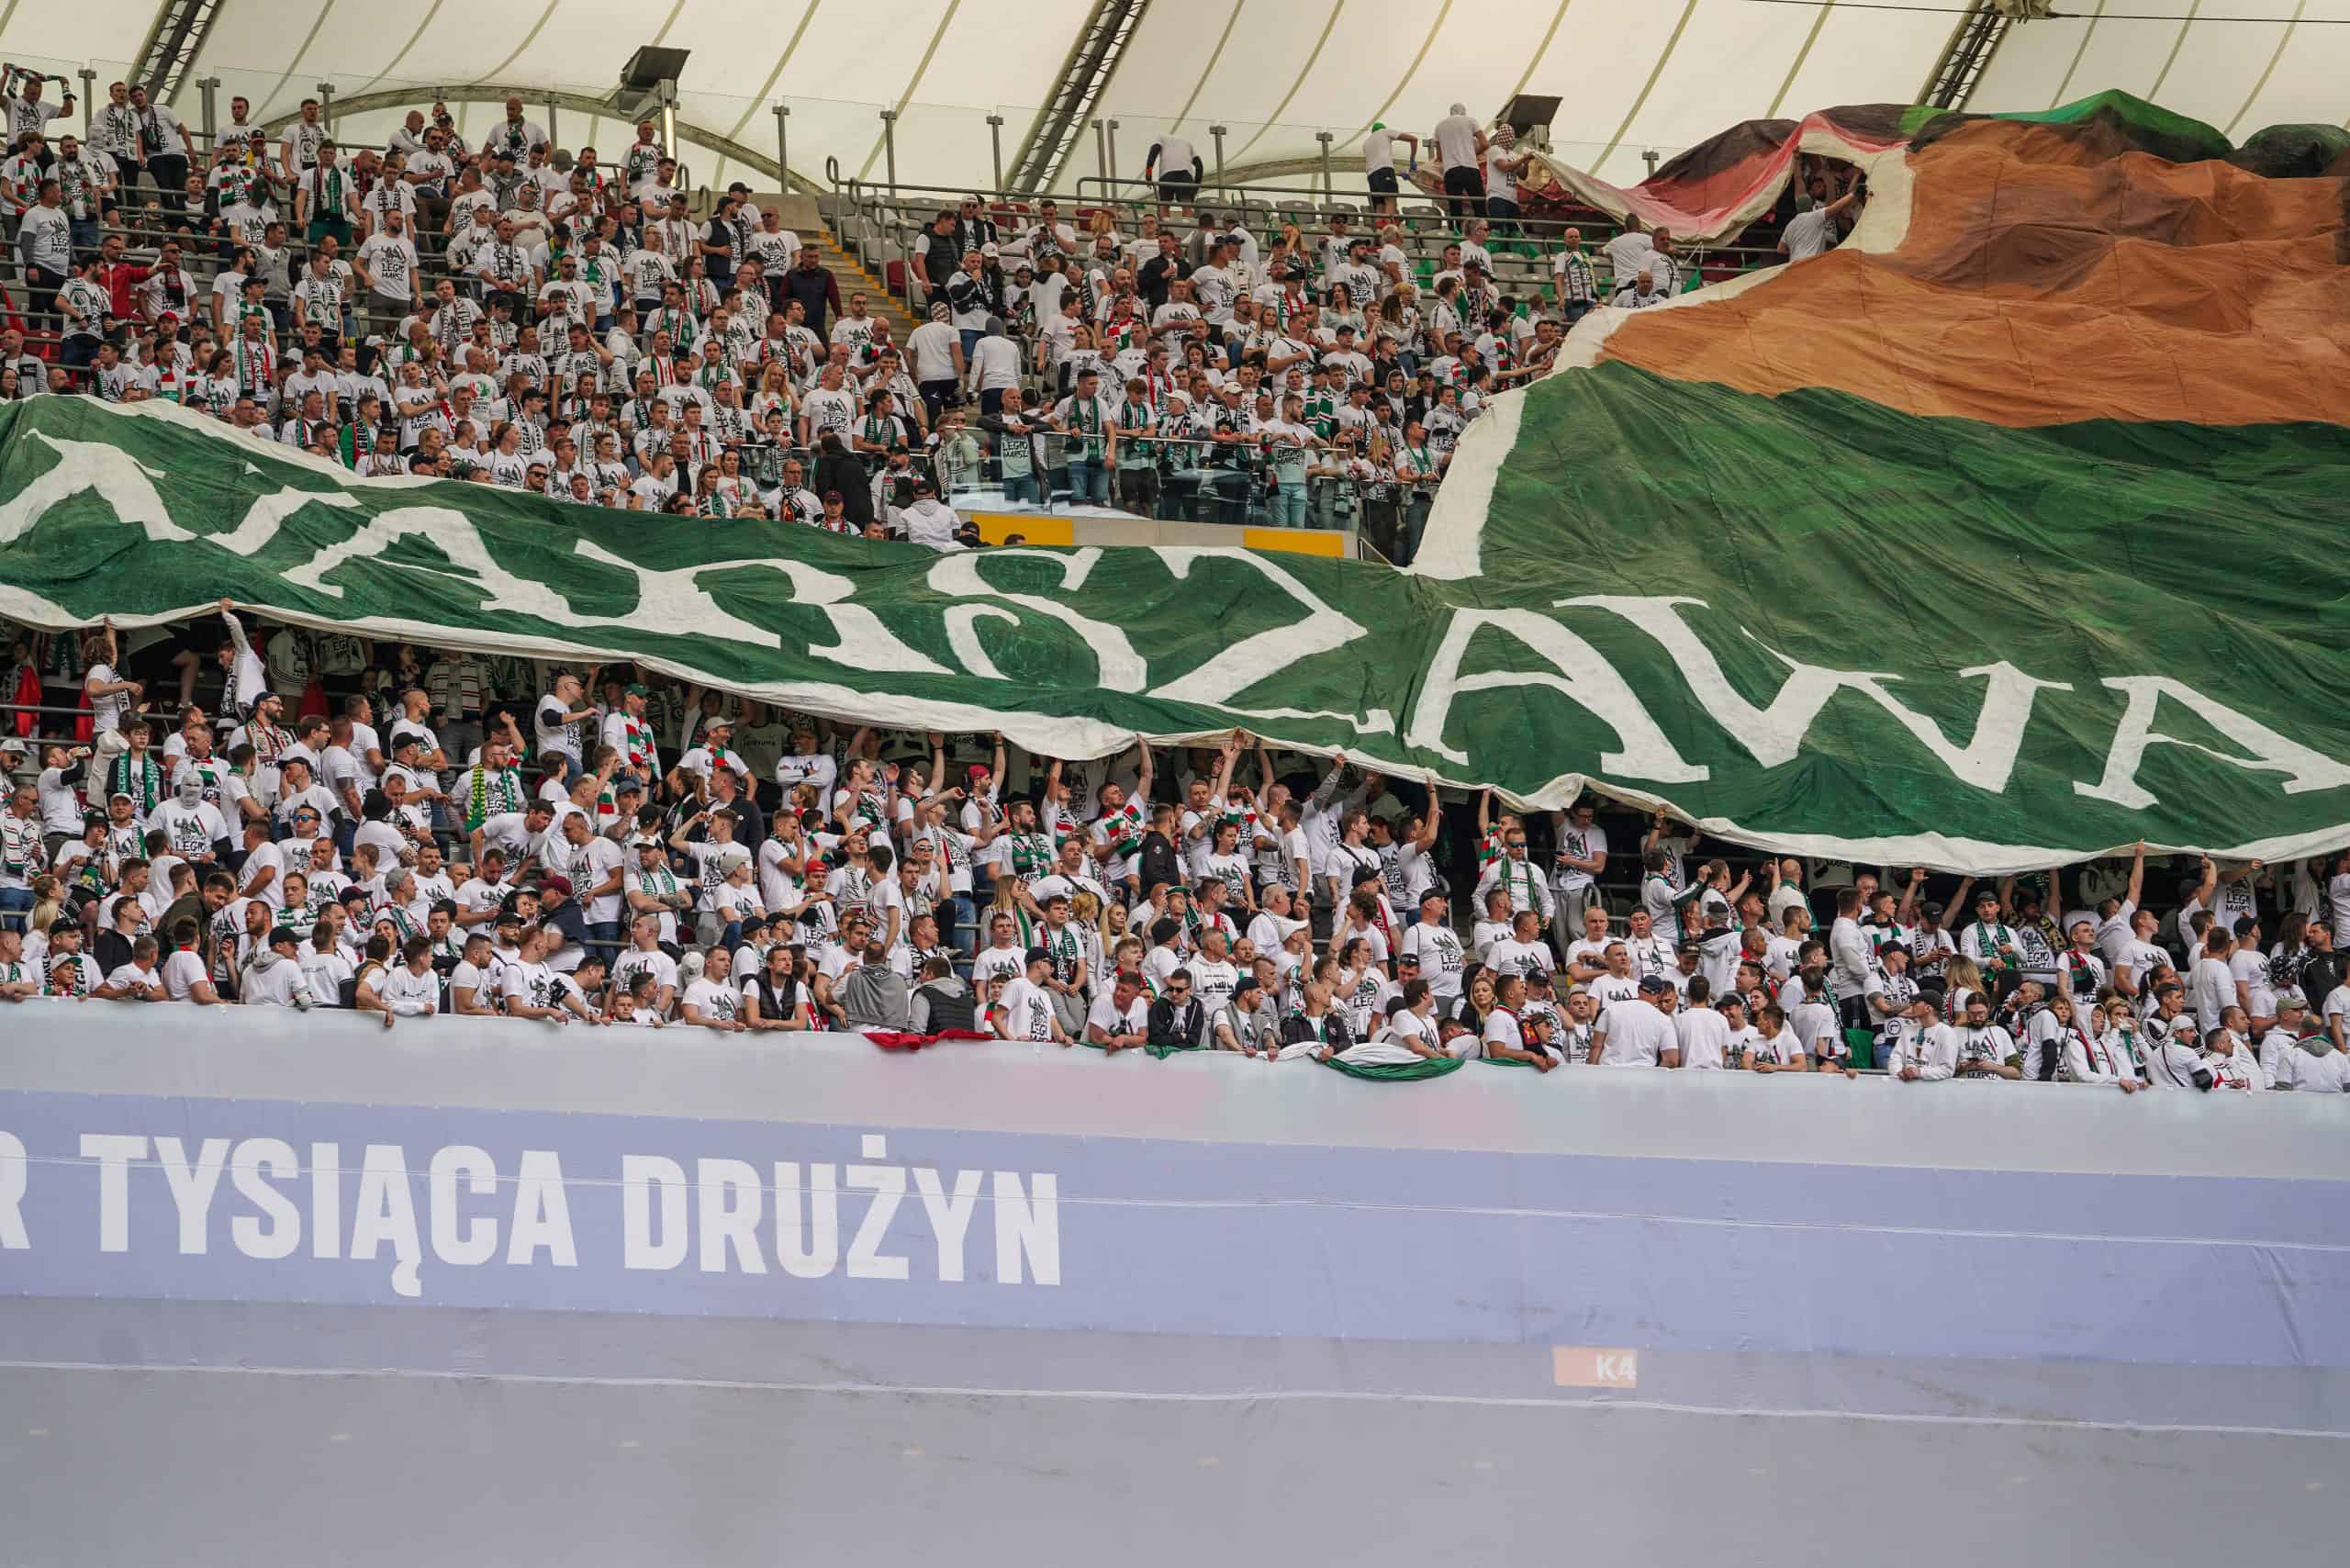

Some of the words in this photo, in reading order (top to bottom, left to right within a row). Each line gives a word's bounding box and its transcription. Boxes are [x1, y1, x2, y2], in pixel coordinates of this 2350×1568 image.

[382, 263, 405, 273] LEGIO
[1002, 440, 1028, 451] LEGIO
[175, 840, 206, 852] LEGIO
[80, 1134, 577, 1296] TYSIĄCA
[622, 1135, 1060, 1285] DRUŻYN
[1596, 1354, 1637, 1381] K4
